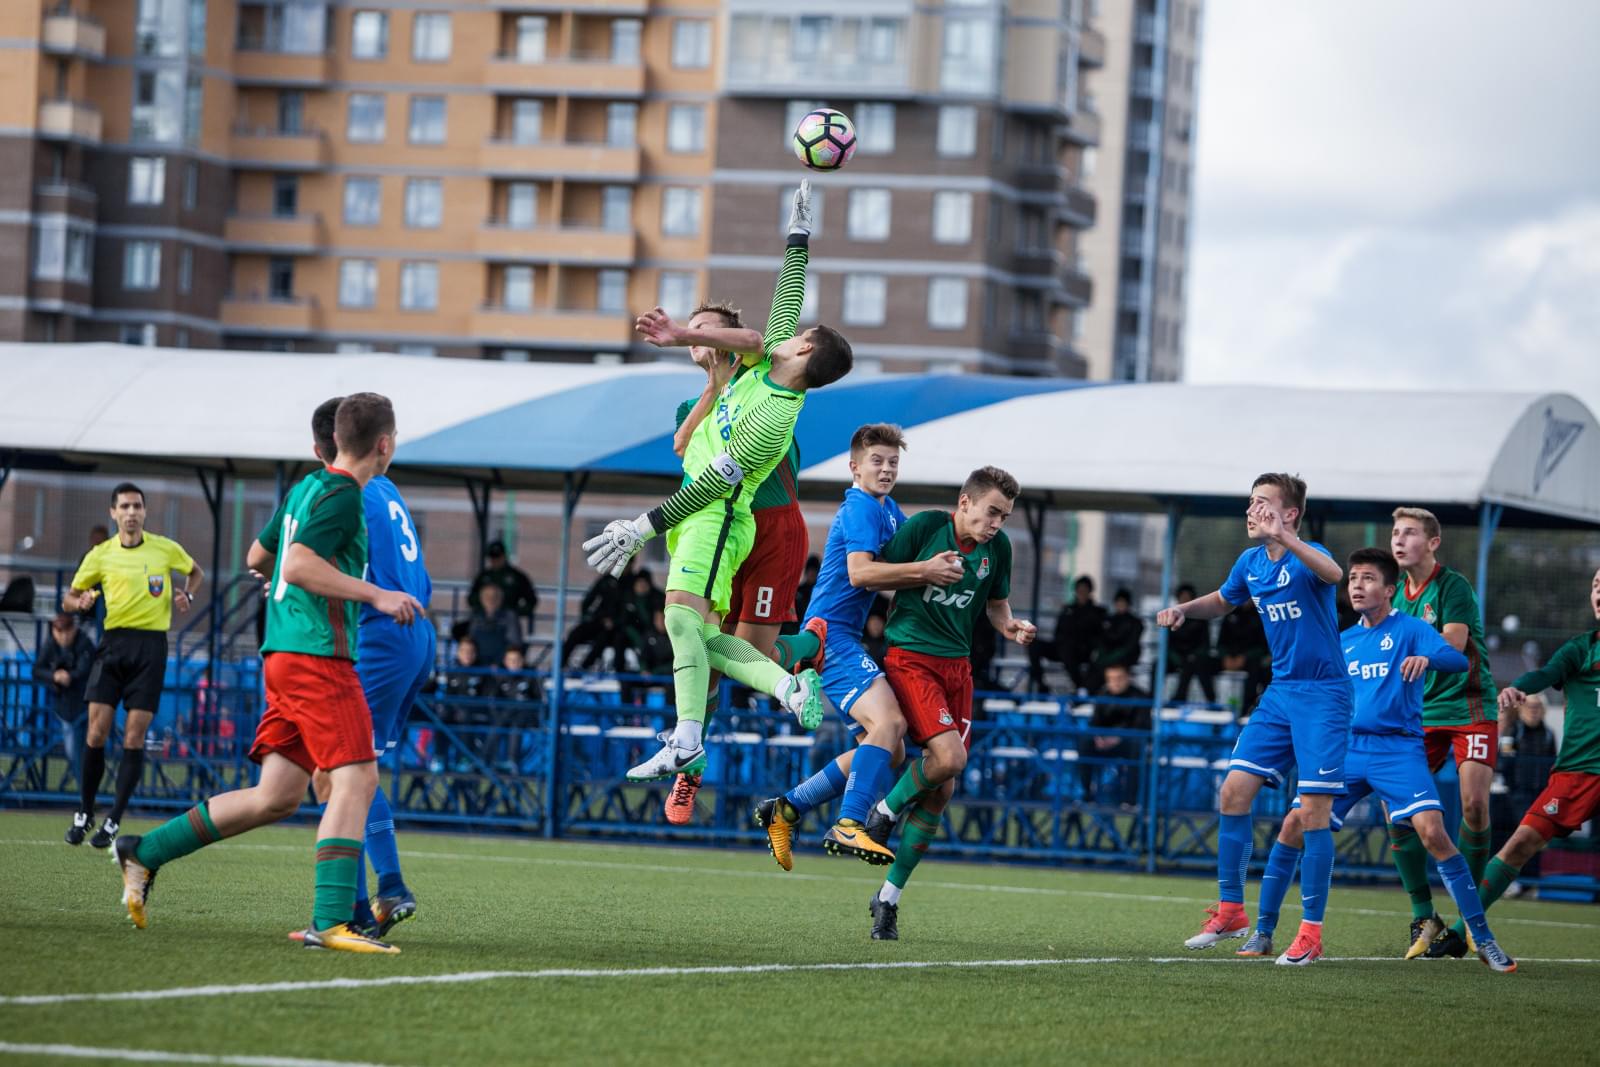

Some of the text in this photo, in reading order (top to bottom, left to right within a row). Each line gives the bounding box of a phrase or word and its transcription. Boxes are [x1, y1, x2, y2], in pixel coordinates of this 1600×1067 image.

[388, 500, 418, 562] 3
[755, 586, 774, 618] 8
[1266, 600, 1302, 622] ВТБ
[1361, 662, 1389, 680] ВТБ
[1465, 734, 1489, 760] 15
